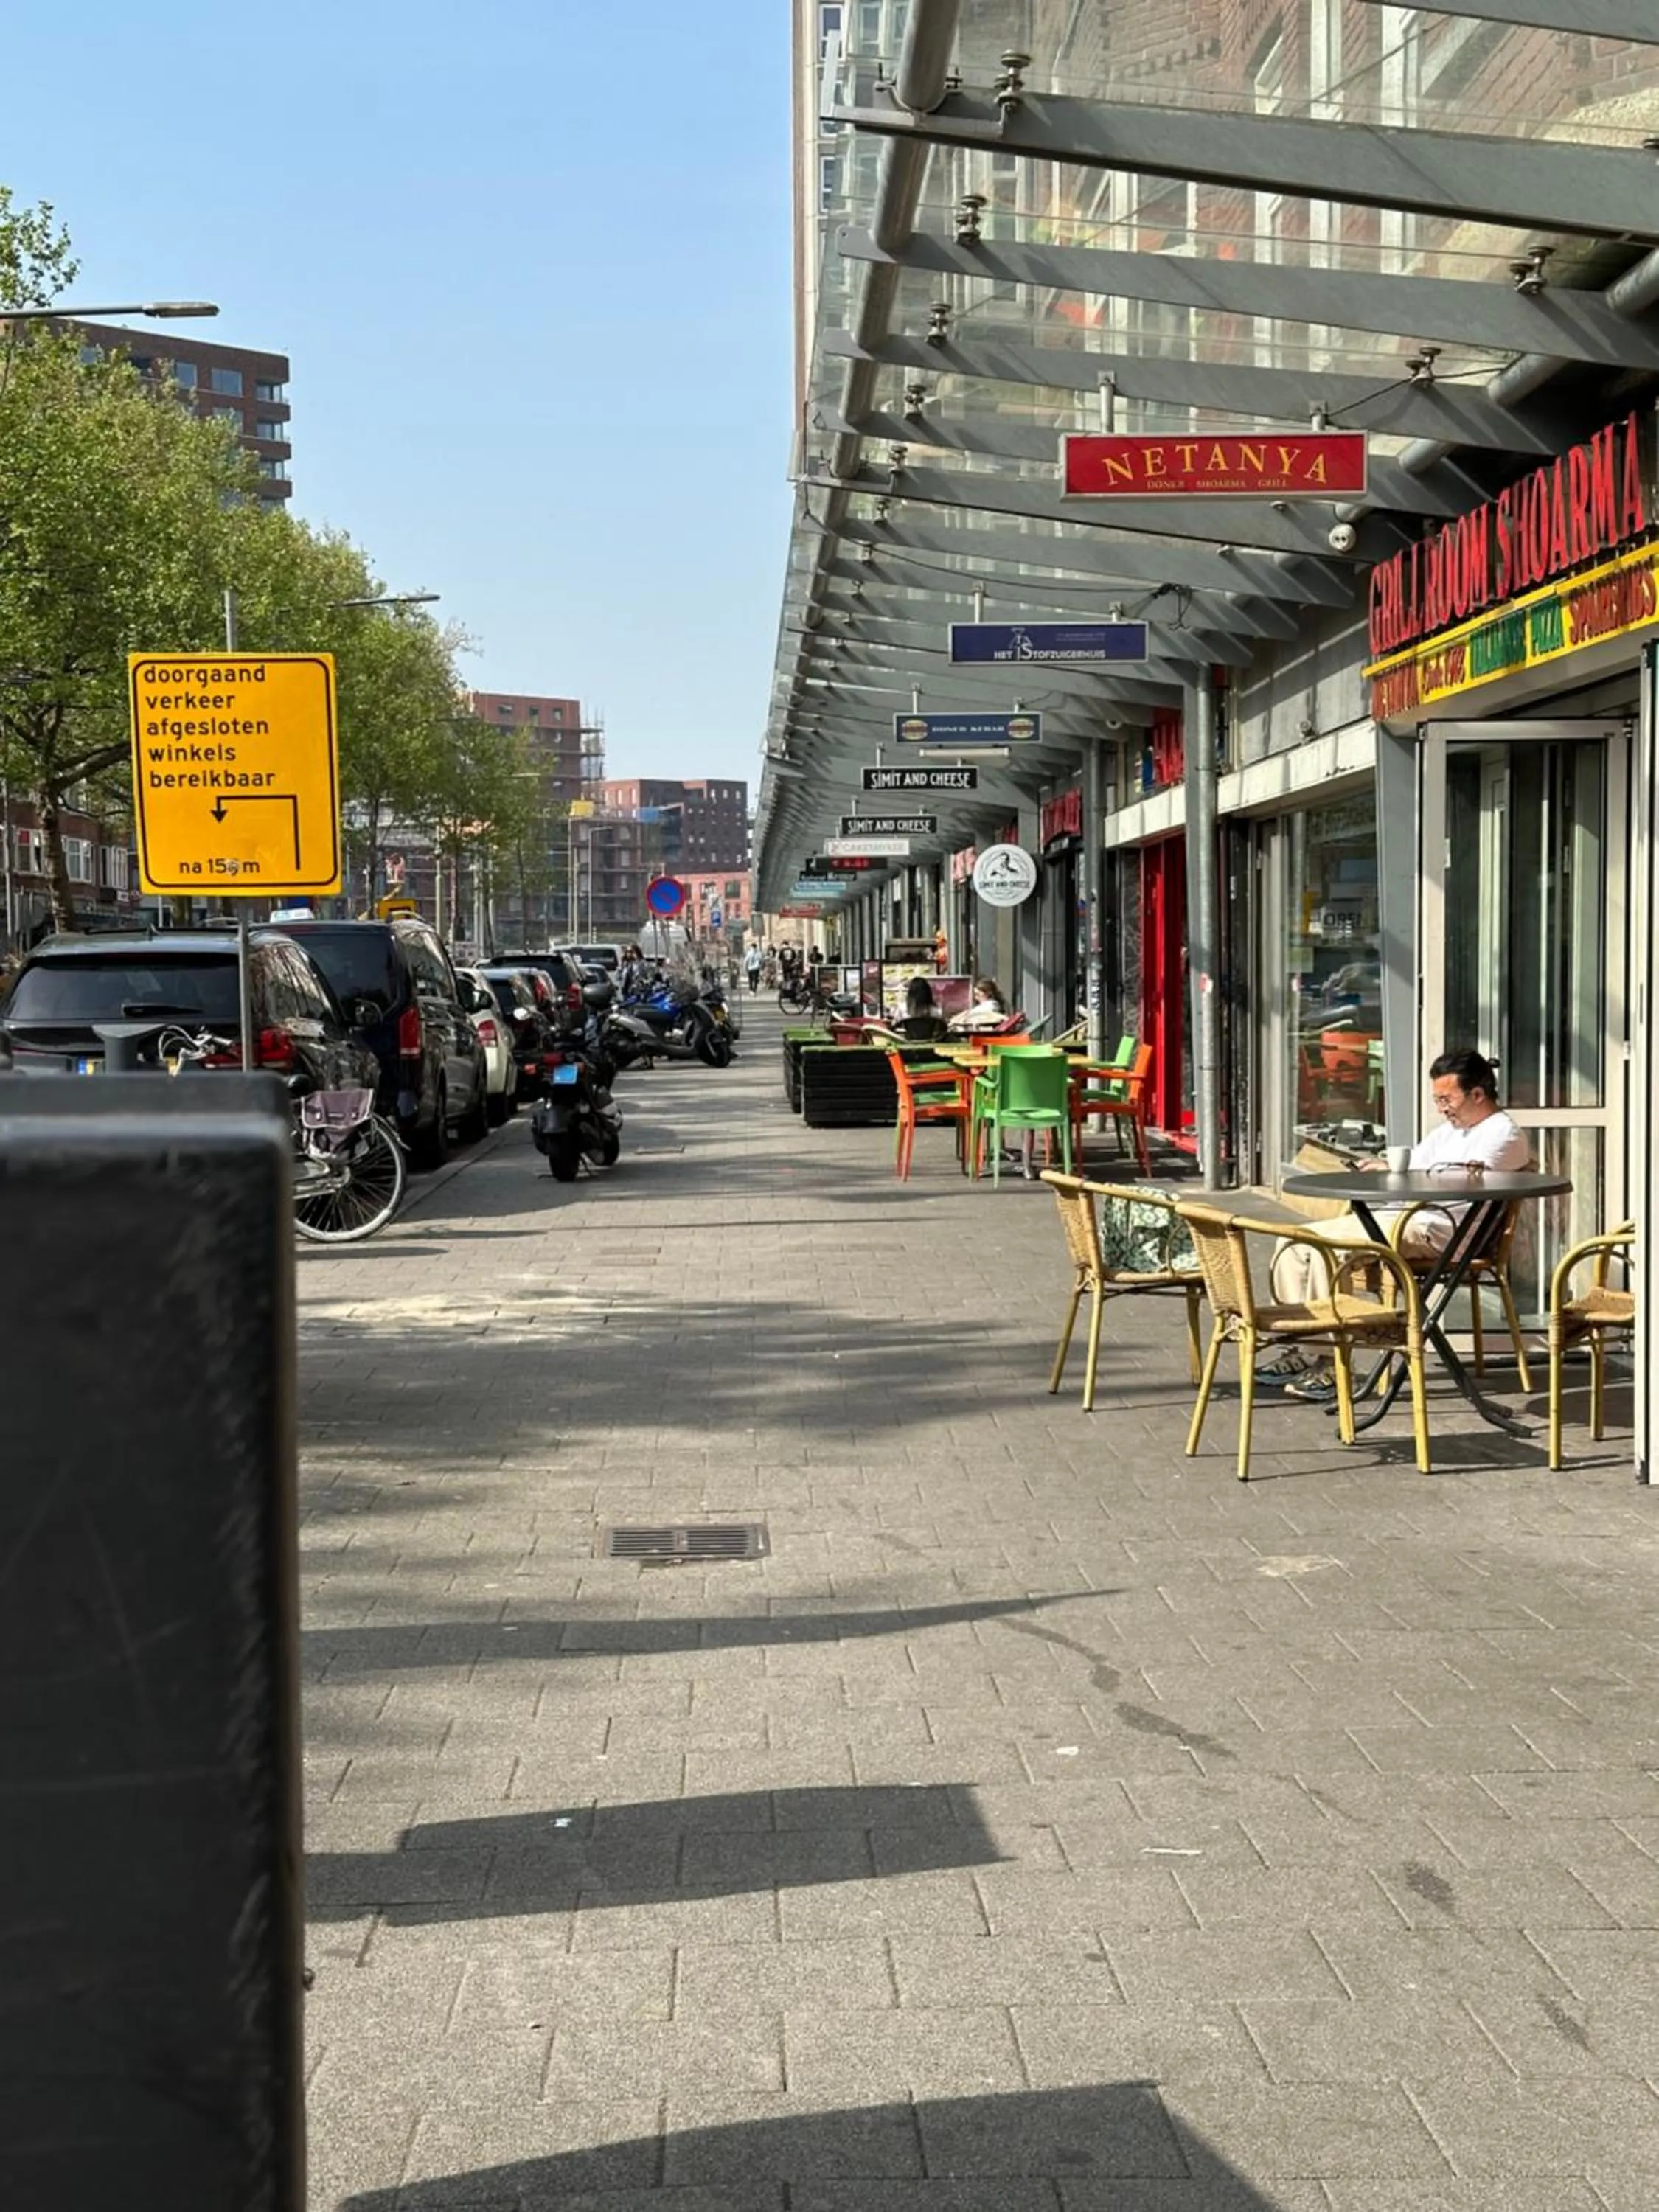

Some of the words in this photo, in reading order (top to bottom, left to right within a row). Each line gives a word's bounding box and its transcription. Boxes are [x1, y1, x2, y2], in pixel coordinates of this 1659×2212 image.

[1102, 442, 1327, 487] NETANYA
[1496, 410, 1645, 599] SHOARMA
[994, 650, 1012, 660] HET
[144, 664, 265, 687] doorgaand
[145, 692, 235, 709] verkeer
[147, 717, 269, 741] afgesloten
[149, 744, 236, 762] winkels
[150, 771, 275, 788] bereikbaar
[903, 772, 928, 786] AND
[930, 772, 971, 789] CHEESE
[874, 819, 895, 832] AND
[897, 819, 931, 833] CHEESE
[179, 861, 202, 874] na
[243, 860, 260, 874] m
